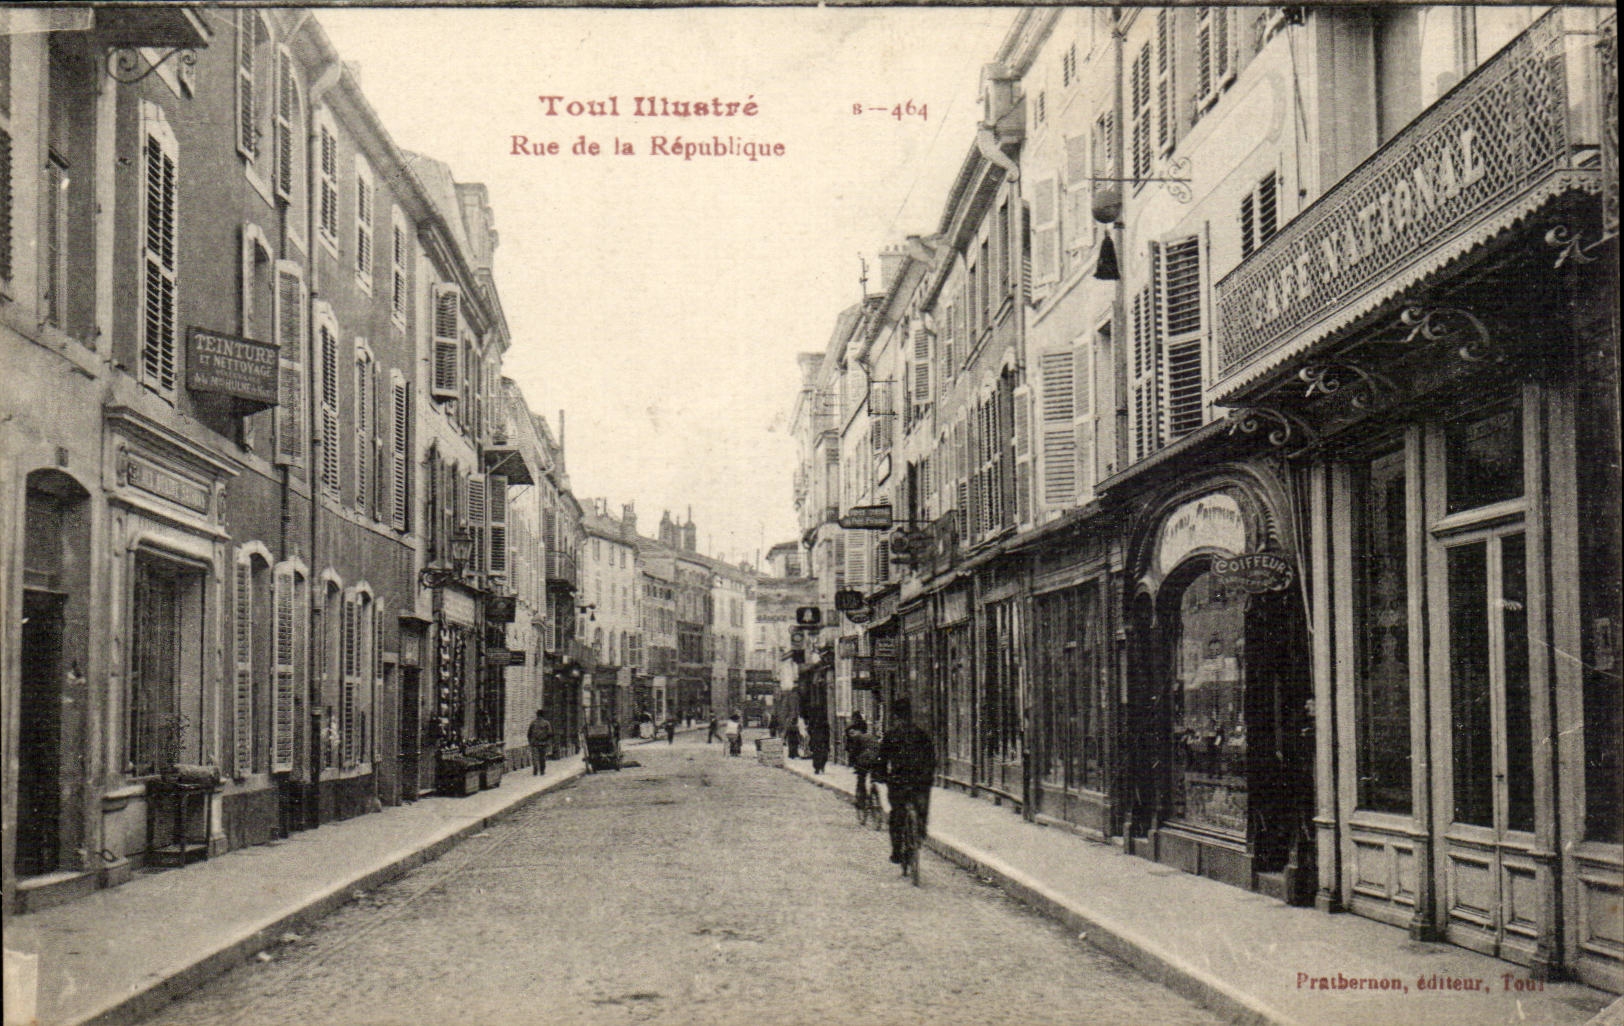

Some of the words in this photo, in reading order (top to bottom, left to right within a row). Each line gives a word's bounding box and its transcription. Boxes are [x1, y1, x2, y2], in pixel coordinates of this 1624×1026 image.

[1321, 129, 1486, 284] NATIONAL
[194, 333, 276, 365] TEINTURE
[200, 354, 211, 364] ET
[214, 354, 273, 377] NETTOYAGE
[1215, 555, 1287, 574] COIFFEUR
